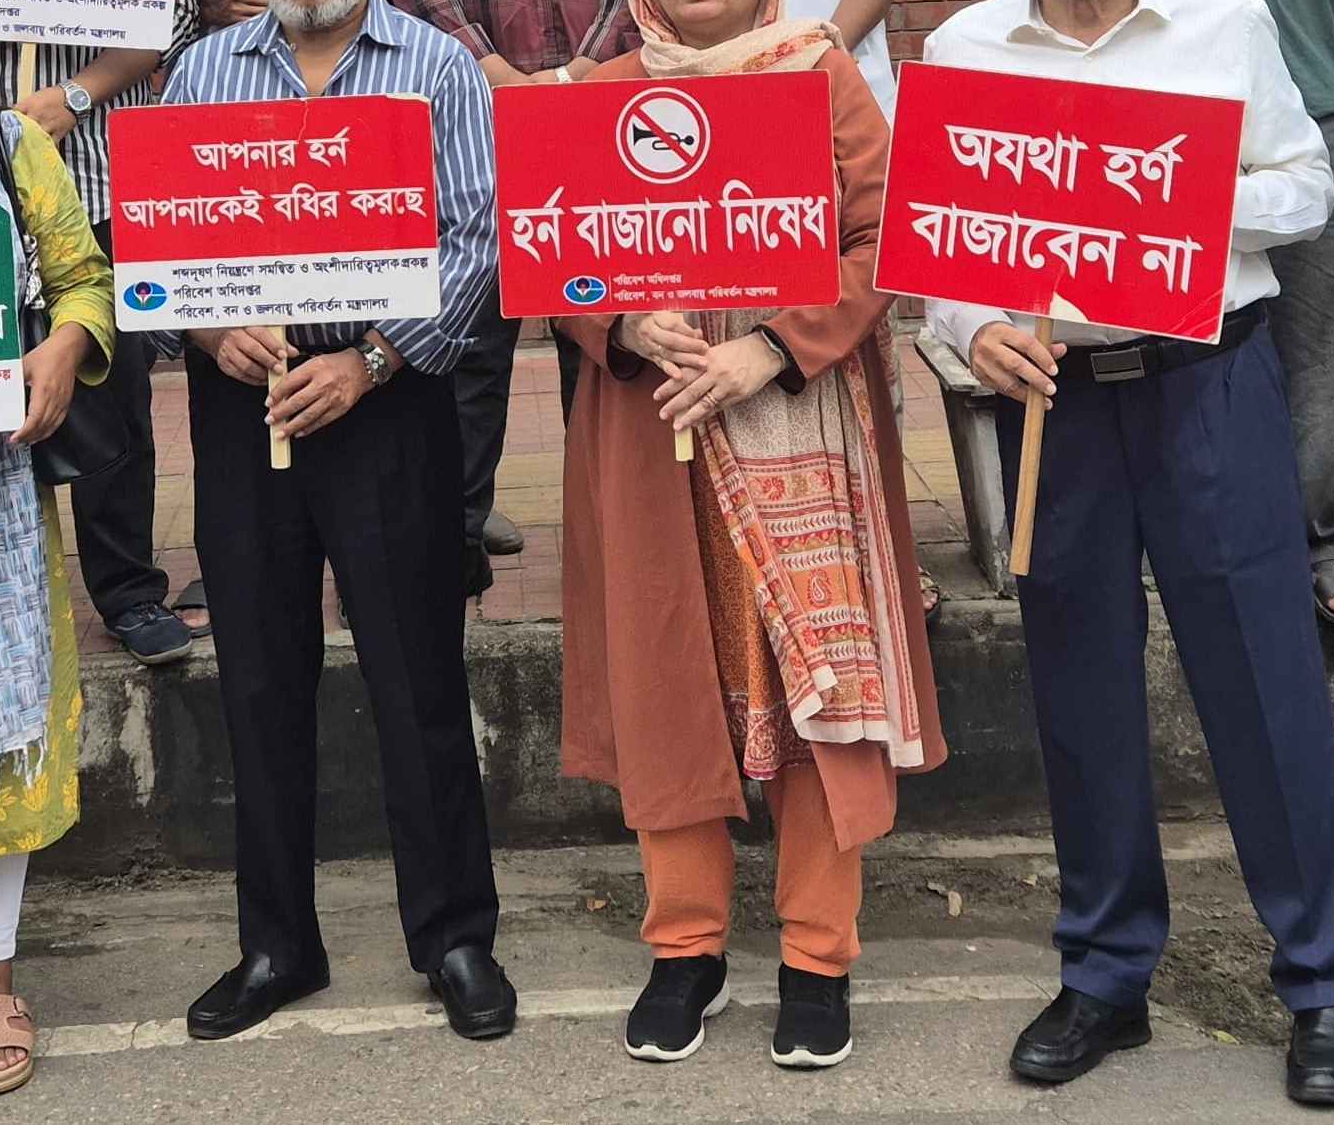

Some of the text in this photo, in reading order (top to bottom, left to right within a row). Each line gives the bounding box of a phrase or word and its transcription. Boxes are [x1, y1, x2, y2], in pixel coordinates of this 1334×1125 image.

[191, 127, 350, 171] আপনার হর্ন
[944, 124, 1187, 205] অযথা হর্ণ
[120, 183, 427, 228] আপনাকেই বধির করছে
[507, 179, 829, 264] হর্ন বাজানো নিষেধ
[908, 202, 1203, 294] বাজাবেন না
[172, 266, 213, 281] শব্দদূষণ
[259, 262, 295, 275] সমন্বিত
[300, 263, 308, 274] ও
[173, 281, 261, 299] পরিবেশ অধিদপ্তর
[224, 305, 240, 317] বন
[244, 305, 252, 316] ও
[256, 301, 293, 317] জলবায়ু
[297, 296, 342, 313] পরিবর্তন
